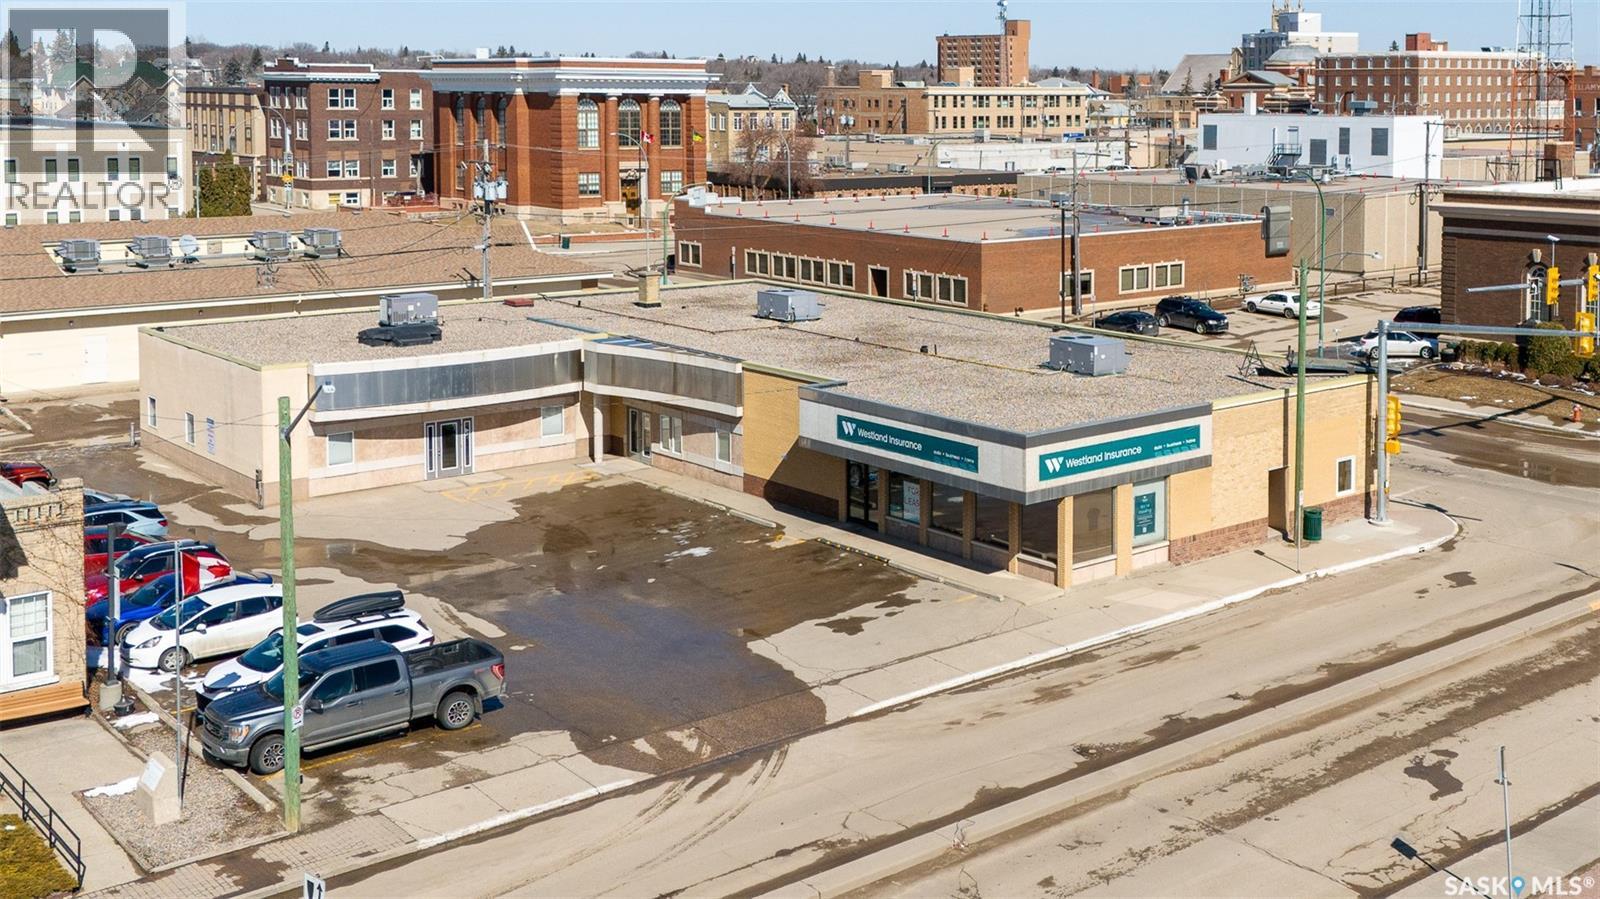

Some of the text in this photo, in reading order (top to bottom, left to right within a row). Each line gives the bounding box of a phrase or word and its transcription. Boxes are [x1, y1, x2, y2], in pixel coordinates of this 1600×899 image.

[858, 428, 888, 443] Westland
[889, 435, 923, 451] Insurance
[1065, 452, 1103, 468] Westland
[1104, 445, 1142, 461] Insurance
